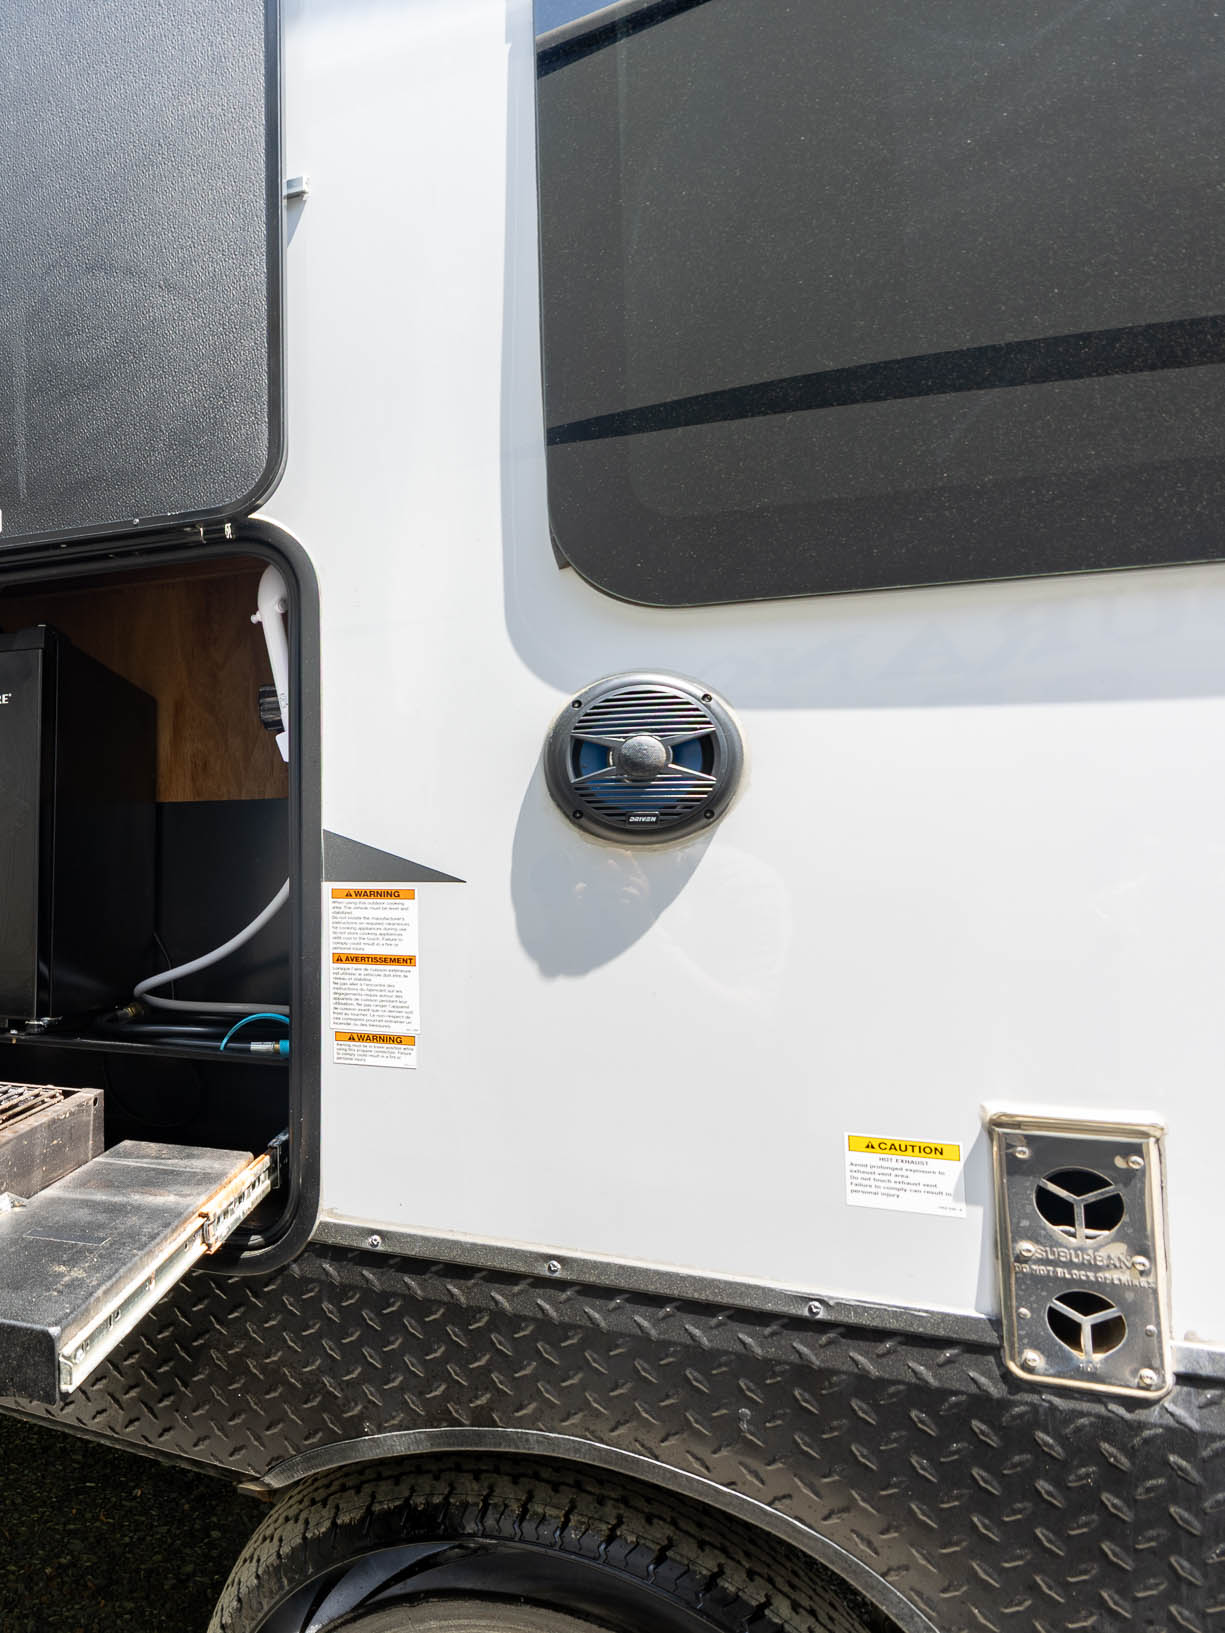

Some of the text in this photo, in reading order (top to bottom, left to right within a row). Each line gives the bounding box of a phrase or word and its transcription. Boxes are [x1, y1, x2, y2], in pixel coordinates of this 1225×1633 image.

[353, 890, 401, 898] WARNING
[344, 955, 414, 965] AVERTISSEMENT
[356, 1034, 403, 1044] WARNING
[878, 1141, 944, 1156] CAUTION
[1034, 1246, 1134, 1270] SUBURBAN
